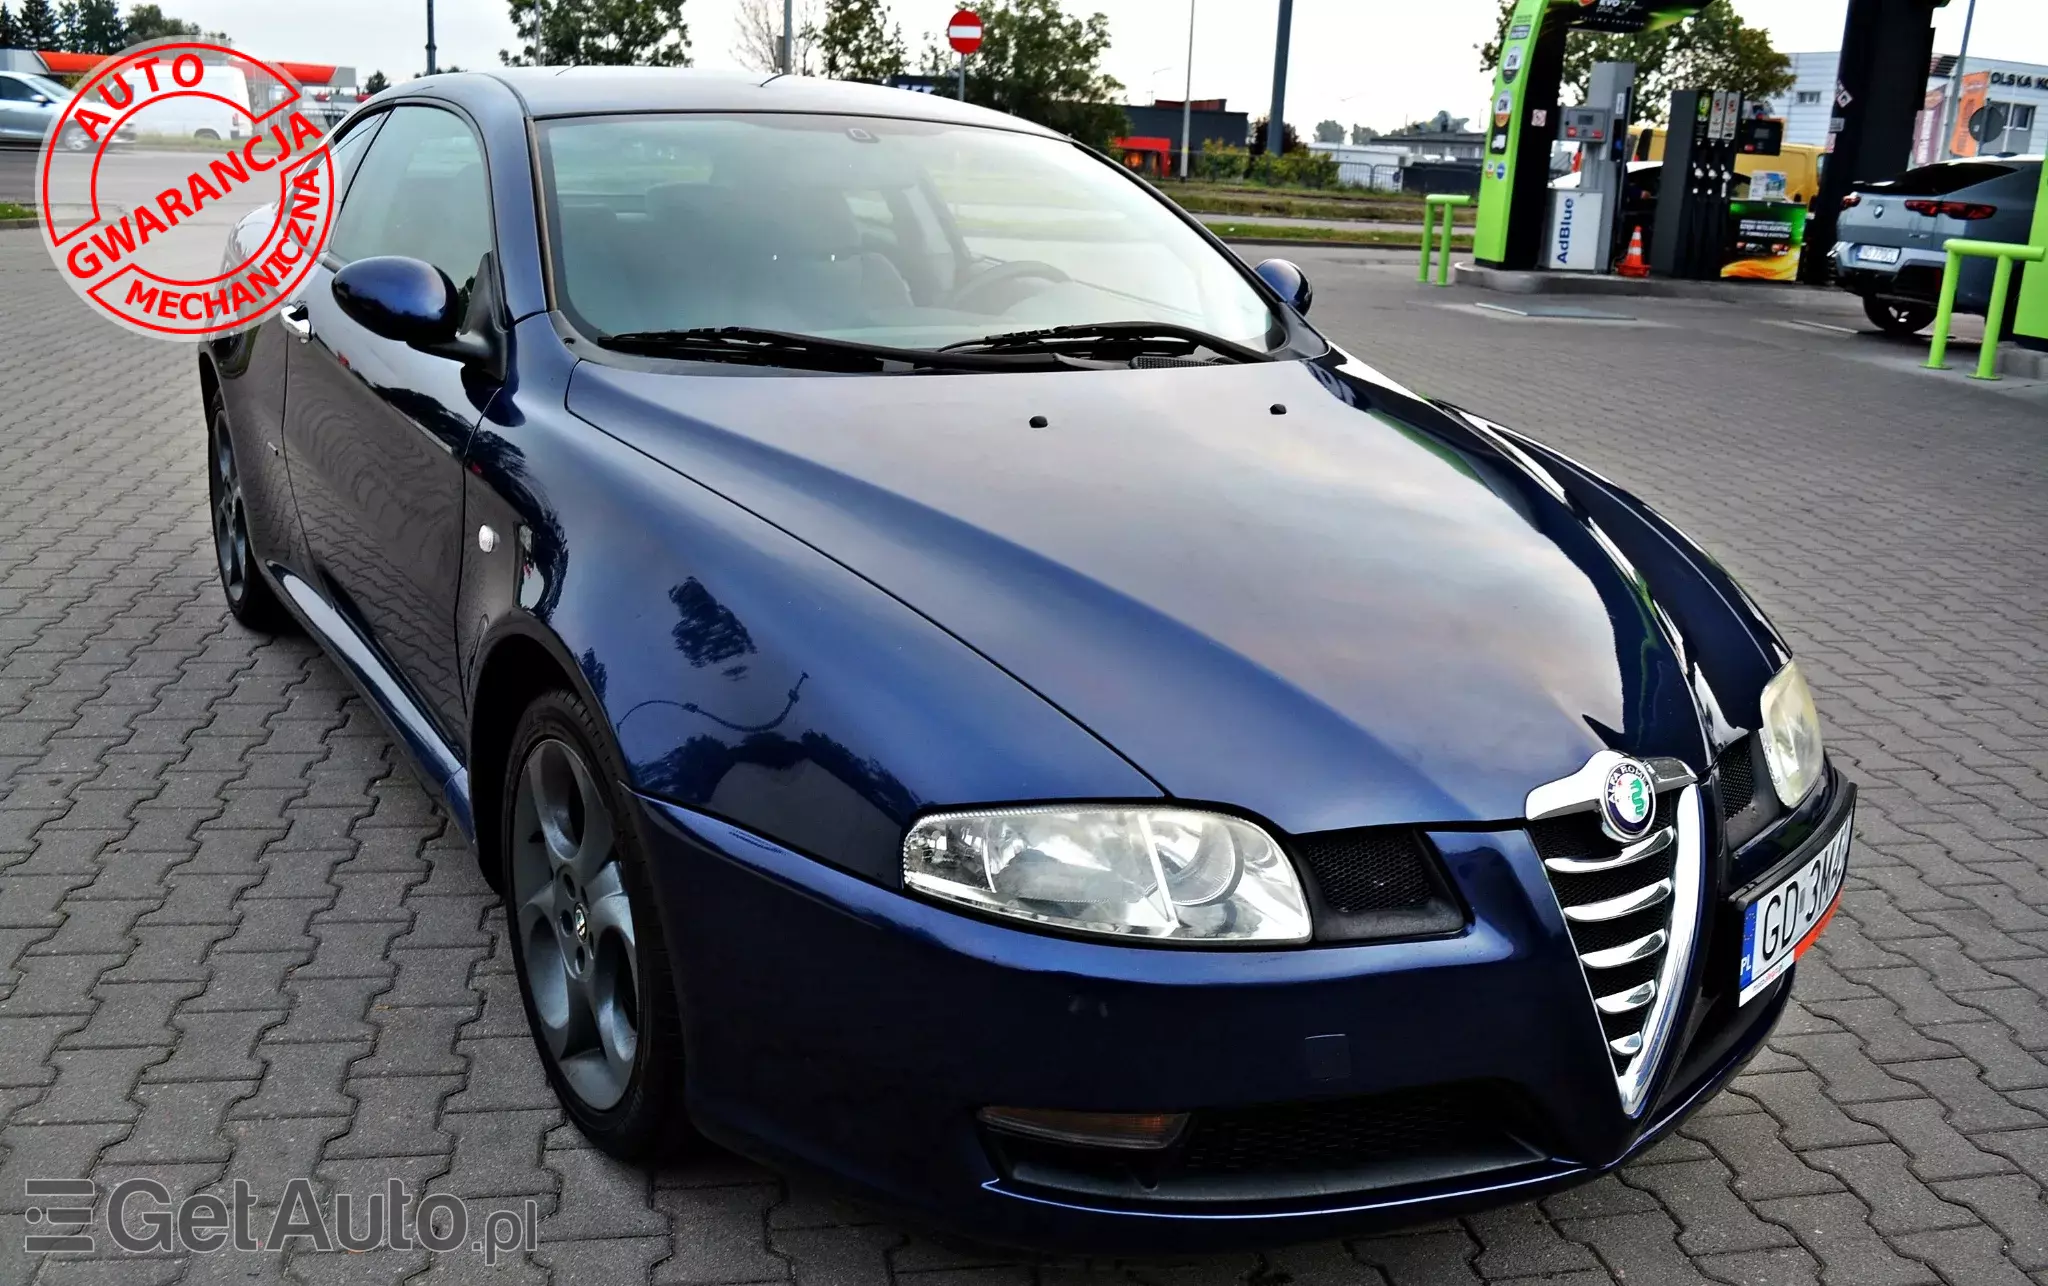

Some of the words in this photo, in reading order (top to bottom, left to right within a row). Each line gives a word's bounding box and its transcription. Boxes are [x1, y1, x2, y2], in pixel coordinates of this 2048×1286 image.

[1991, 71, 2032, 88] OLSKA
[1556, 198, 1574, 265] AdBlue
[1607, 770, 1621, 804] ALFA
[1762, 880, 1799, 962] GD
[1740, 953, 1752, 976] PL
